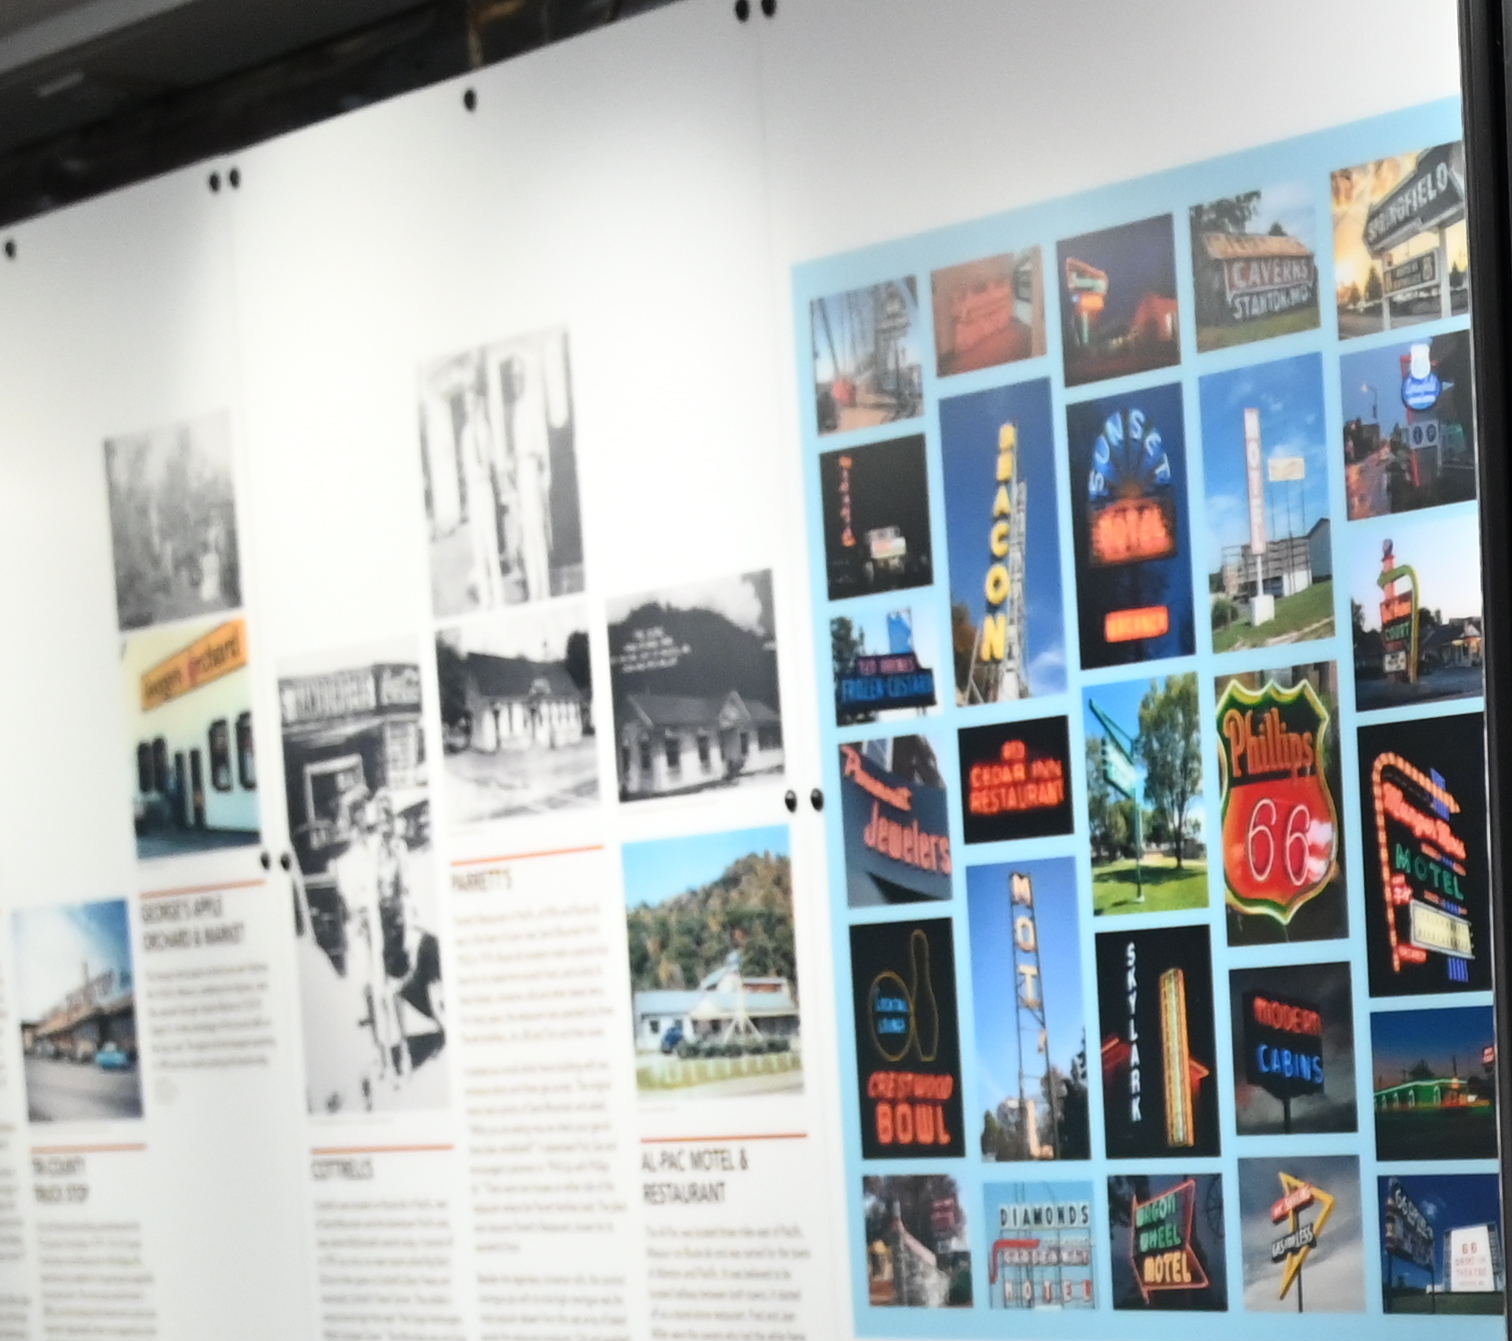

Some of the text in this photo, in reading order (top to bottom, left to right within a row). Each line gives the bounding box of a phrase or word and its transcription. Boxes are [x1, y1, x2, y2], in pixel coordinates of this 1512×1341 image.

[1232, 259, 1309, 287] CAVERNS
[1223, 706, 1315, 788] Phillips
[1247, 797, 1311, 887] 66
[1394, 841, 1465, 901] MOTEL
[1257, 1043, 1324, 1084] CABINS
[875, 1102, 952, 1145] BOWL
[1000, 1203, 1090, 1228] DIAMONDS
[1144, 1250, 1192, 1285] MOTEL
